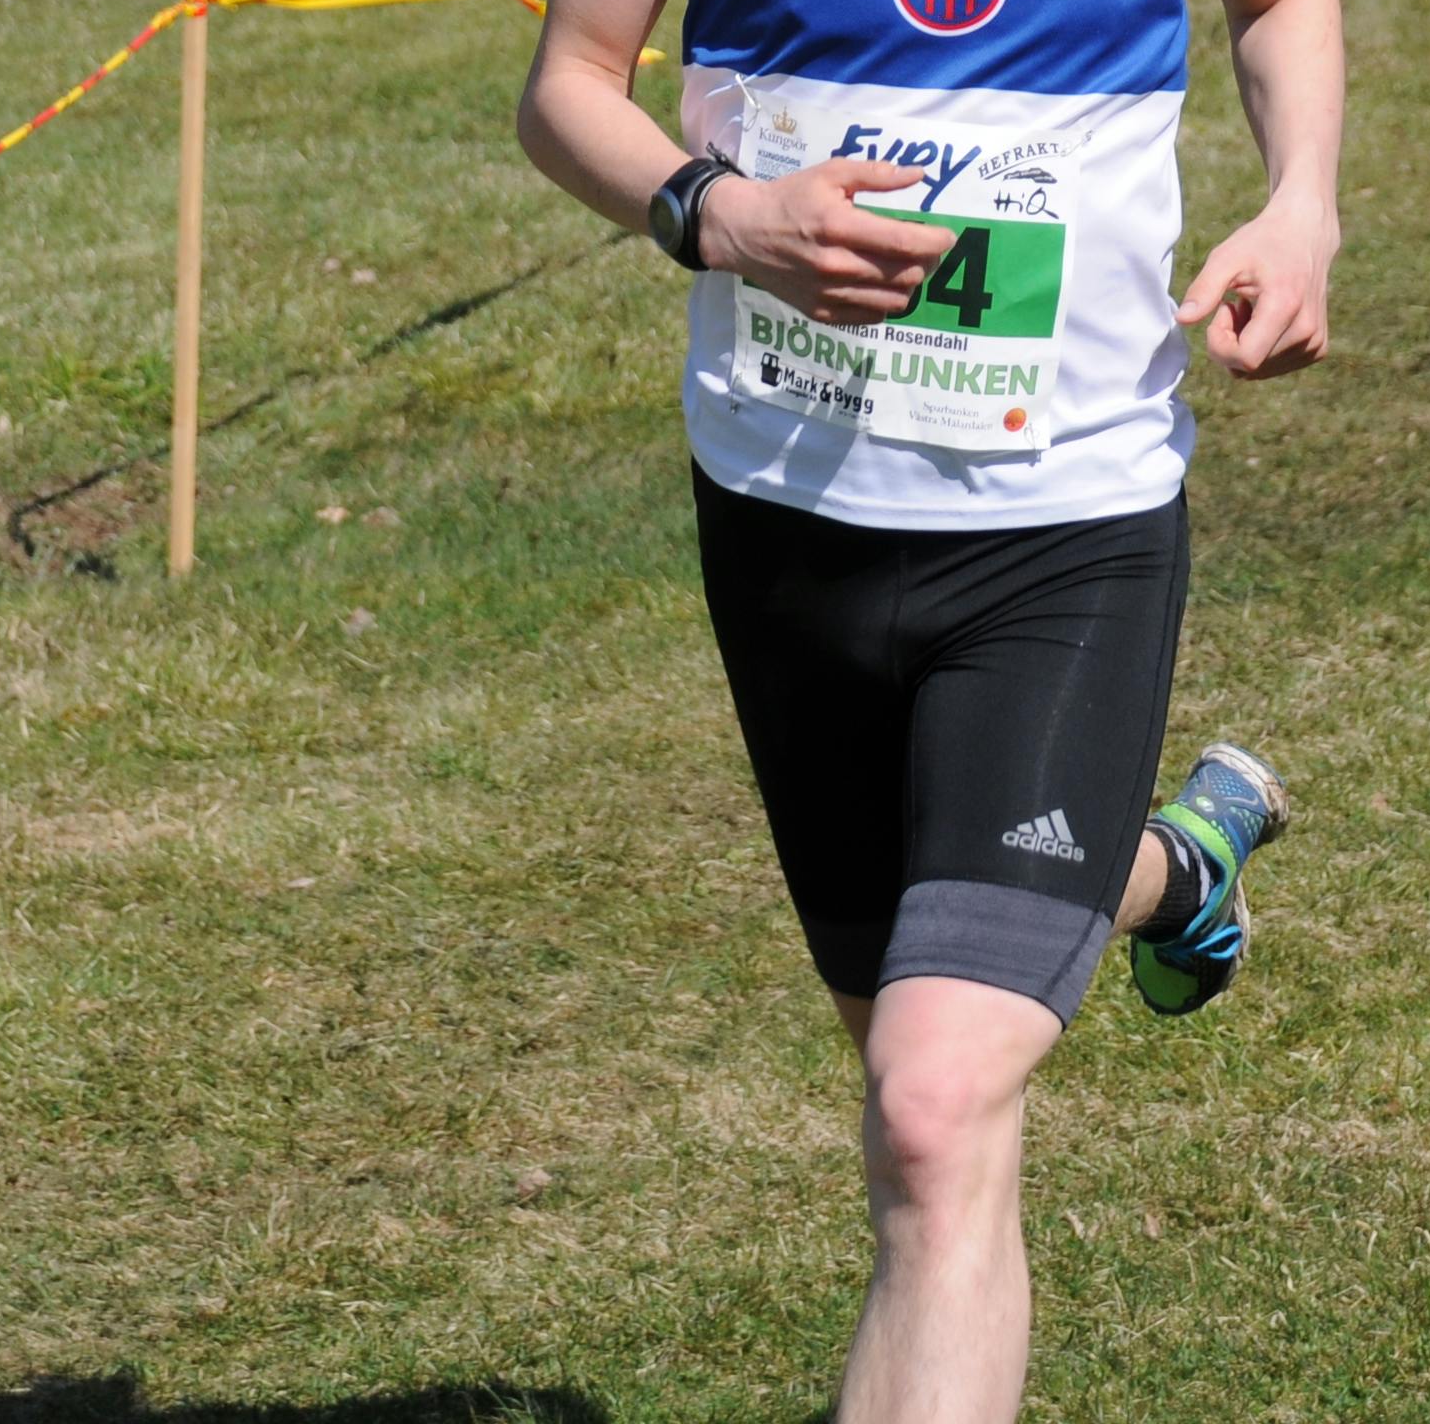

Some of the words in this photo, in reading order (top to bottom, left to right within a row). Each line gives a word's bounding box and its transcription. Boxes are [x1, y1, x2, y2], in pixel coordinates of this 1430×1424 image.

[758, 126, 808, 152] Kungsör
[751, 311, 1040, 396] BJÖRNLUNKEN
[884, 325, 969, 352] Rosendahl
[783, 367, 818, 394] Mark
[819, 380, 833, 404] &
[834, 386, 874, 415] Bygg
[1002, 830, 1085, 863] adidas
